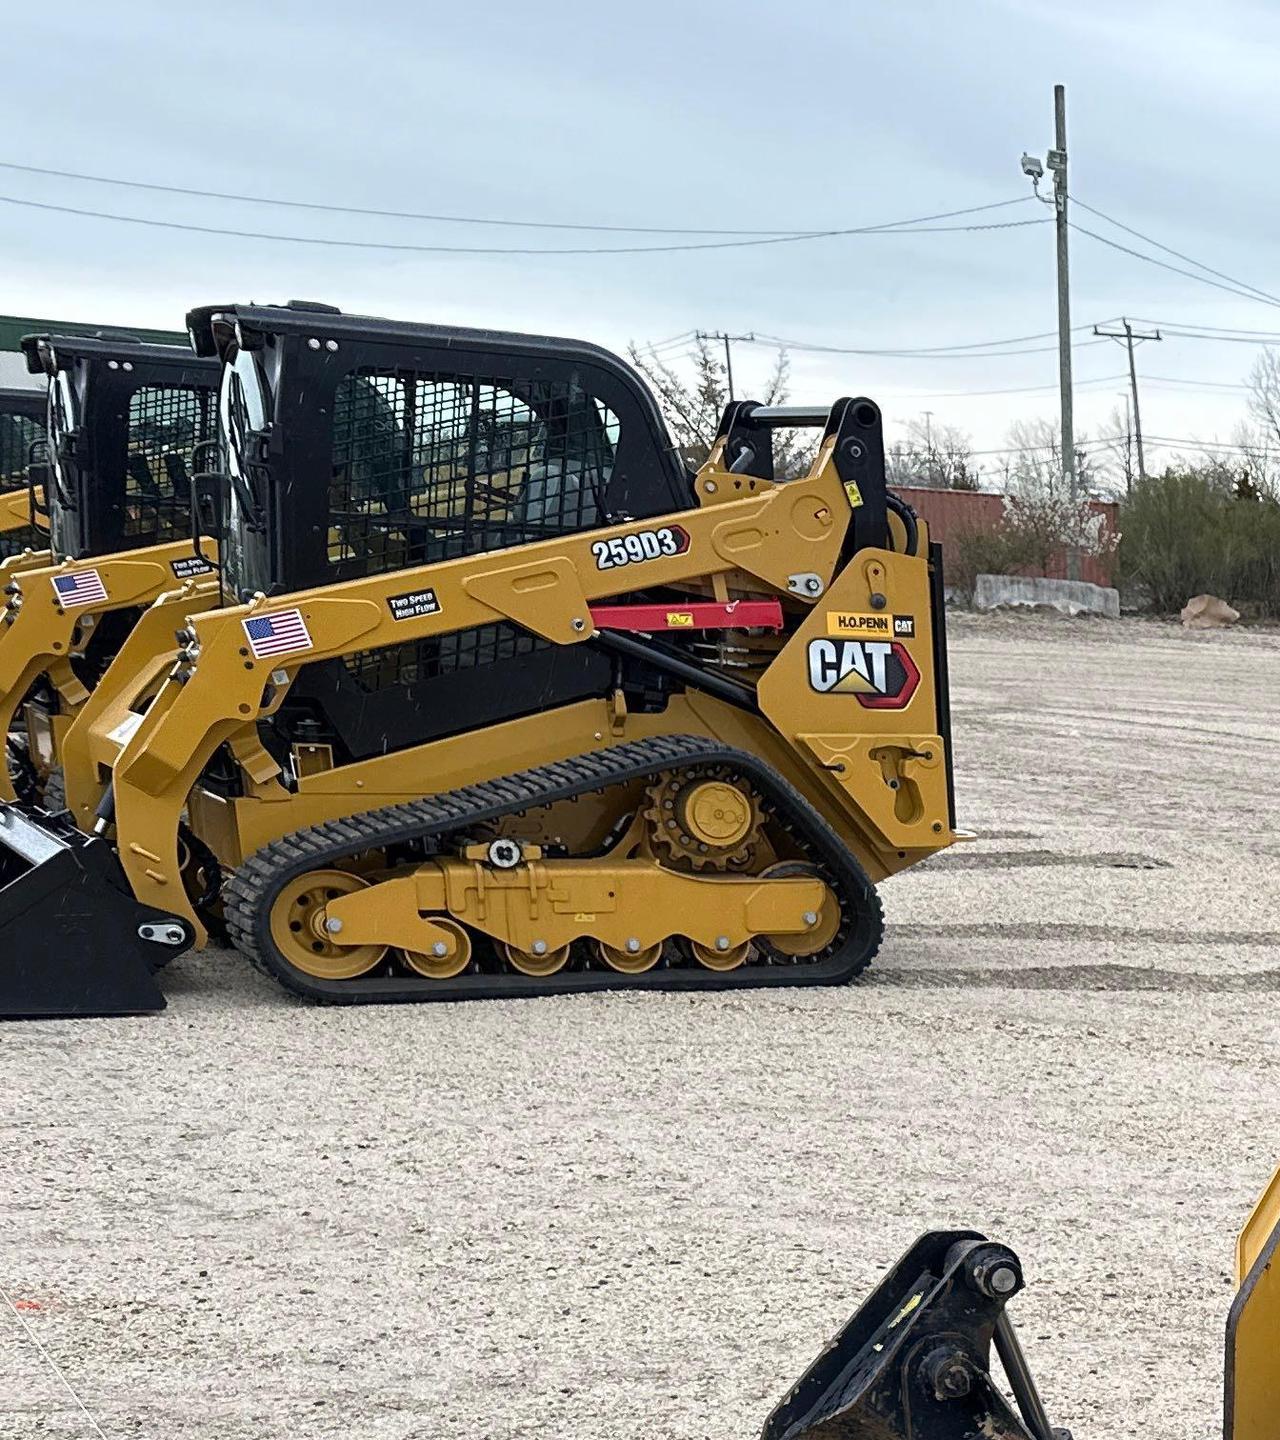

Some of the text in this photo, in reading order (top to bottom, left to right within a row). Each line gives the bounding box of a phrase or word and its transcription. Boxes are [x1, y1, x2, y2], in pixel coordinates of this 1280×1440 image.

[593, 528, 677, 569] 259D3
[895, 620, 913, 633] CAT
[809, 639, 892, 694] CAT
